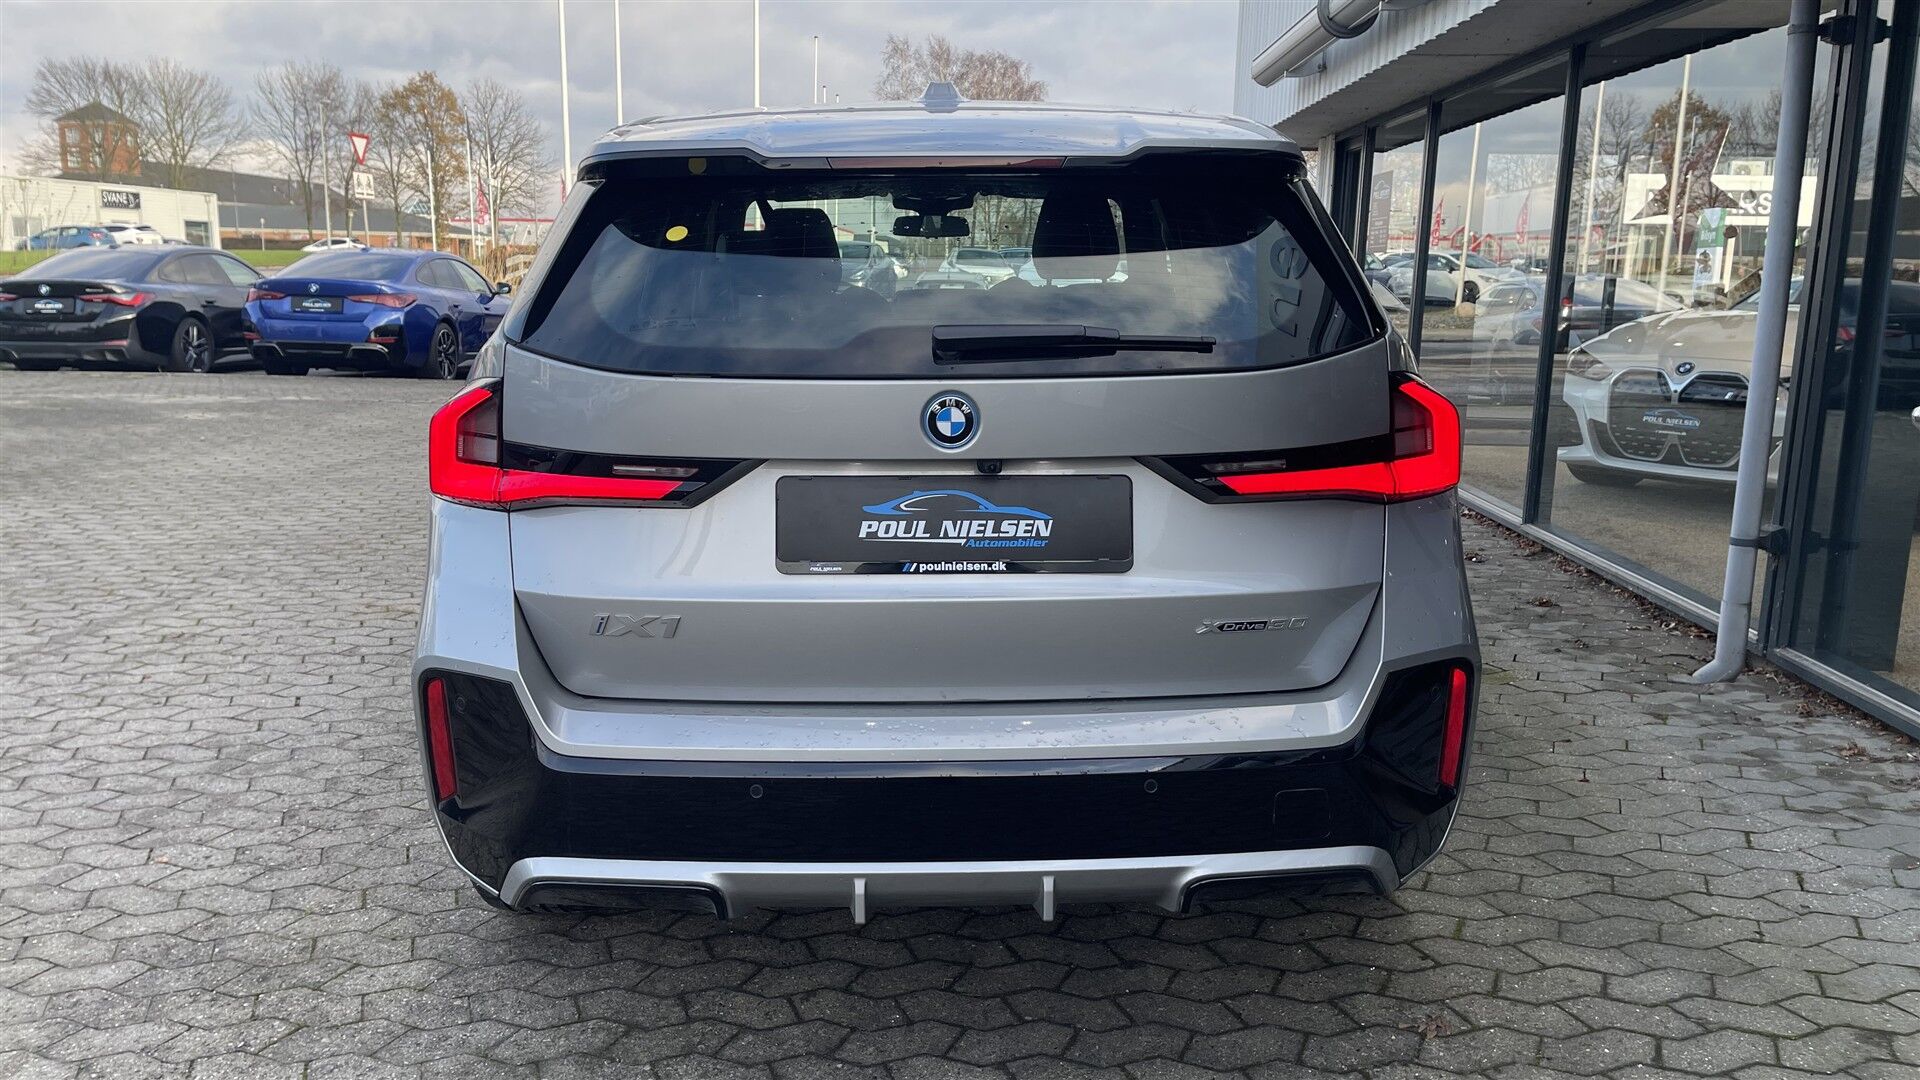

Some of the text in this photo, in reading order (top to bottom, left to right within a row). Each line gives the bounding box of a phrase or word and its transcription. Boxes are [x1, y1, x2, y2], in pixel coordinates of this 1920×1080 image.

[102, 191, 128, 204] SVANE
[932, 398, 971, 414] BMW
[858, 520, 1054, 538] POUL NIELSEN
[965, 538, 1049, 549] Automobiler
[919, 562, 1007, 573] poulnielsen.dk
